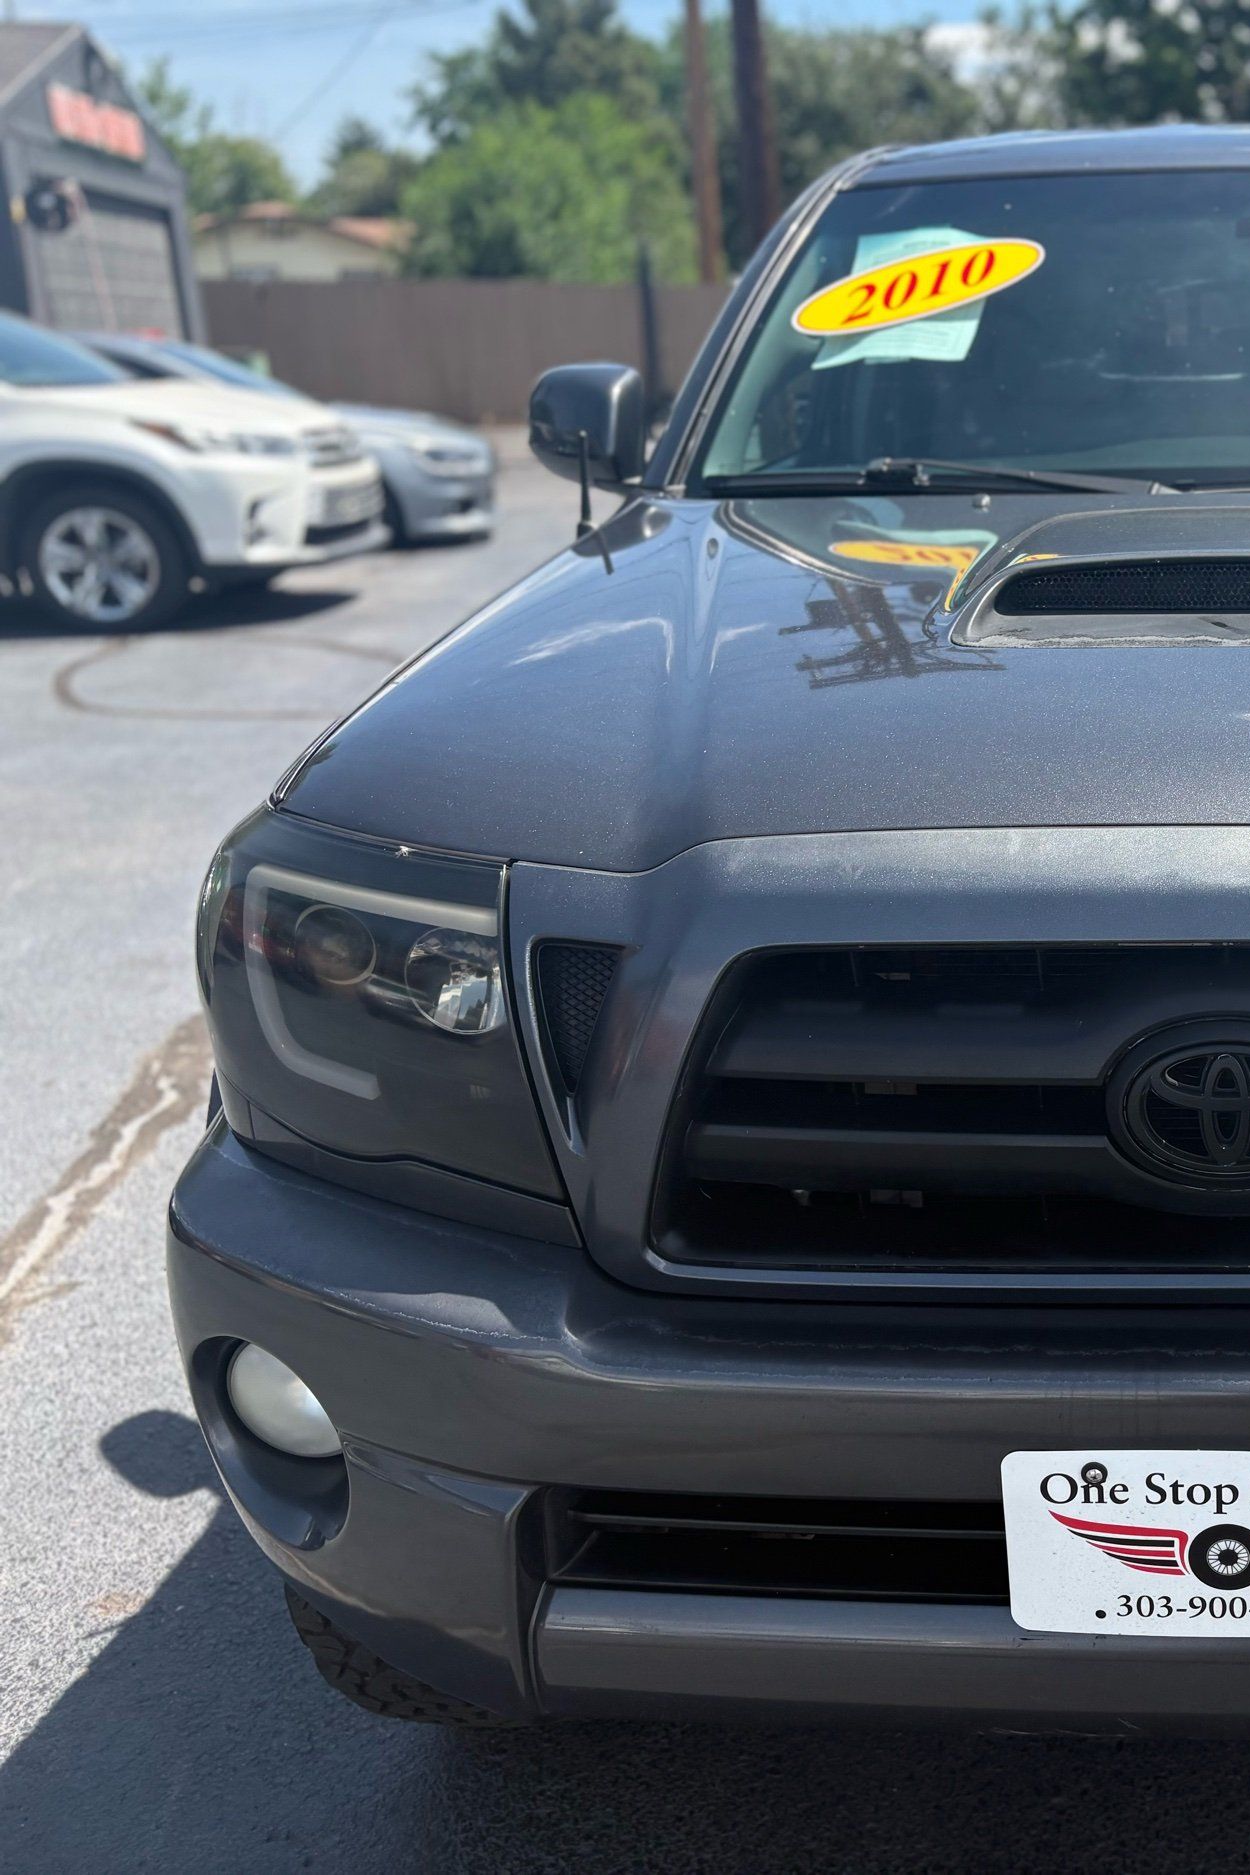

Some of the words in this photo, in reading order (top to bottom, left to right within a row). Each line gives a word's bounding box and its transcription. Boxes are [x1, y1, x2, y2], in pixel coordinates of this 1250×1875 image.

[842, 248, 996, 326] 2010
[1040, 1472, 1130, 1505] One
[1145, 1472, 1240, 1515] Stop
